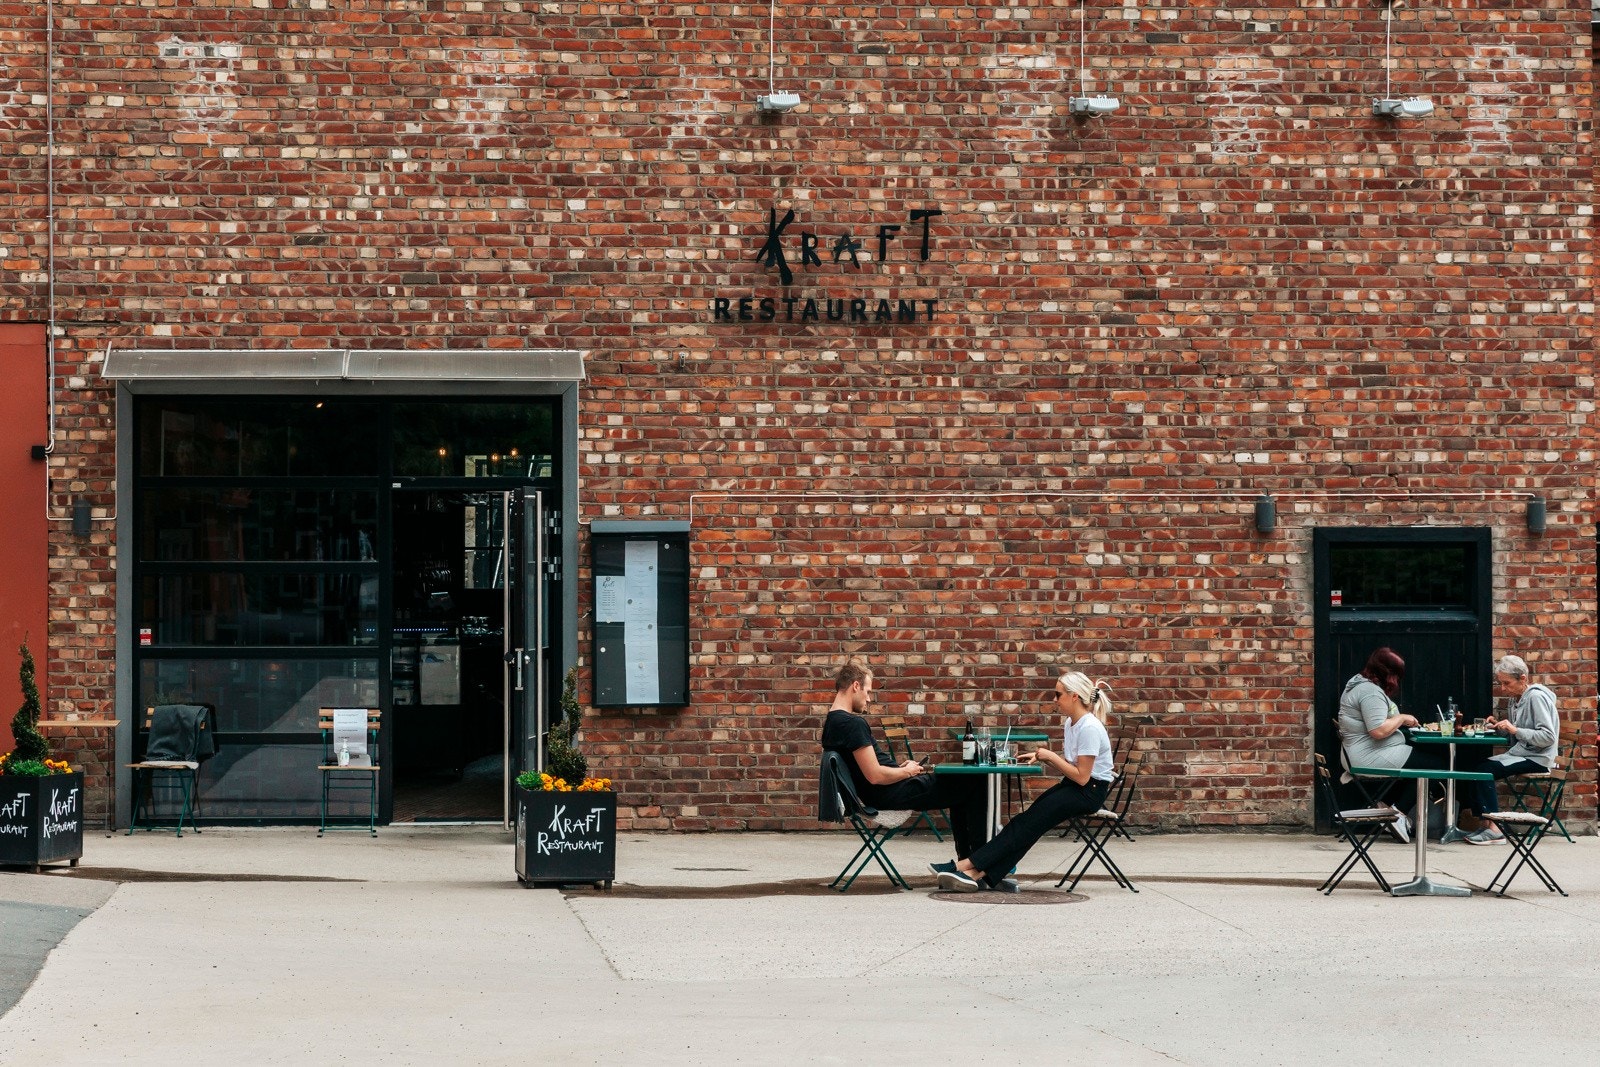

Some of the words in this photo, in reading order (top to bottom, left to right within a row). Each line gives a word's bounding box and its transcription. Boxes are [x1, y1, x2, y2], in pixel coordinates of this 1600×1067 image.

[756, 207, 942, 286] KRAFT
[714, 297, 938, 321] RESTAURANT
[0, 792, 31, 819] AFT
[49, 788, 79, 822] KRAFT
[43, 816, 78, 839] RESTAURANT
[548, 804, 606, 840] KRAFT
[537, 831, 604, 856] RESTAURANT
